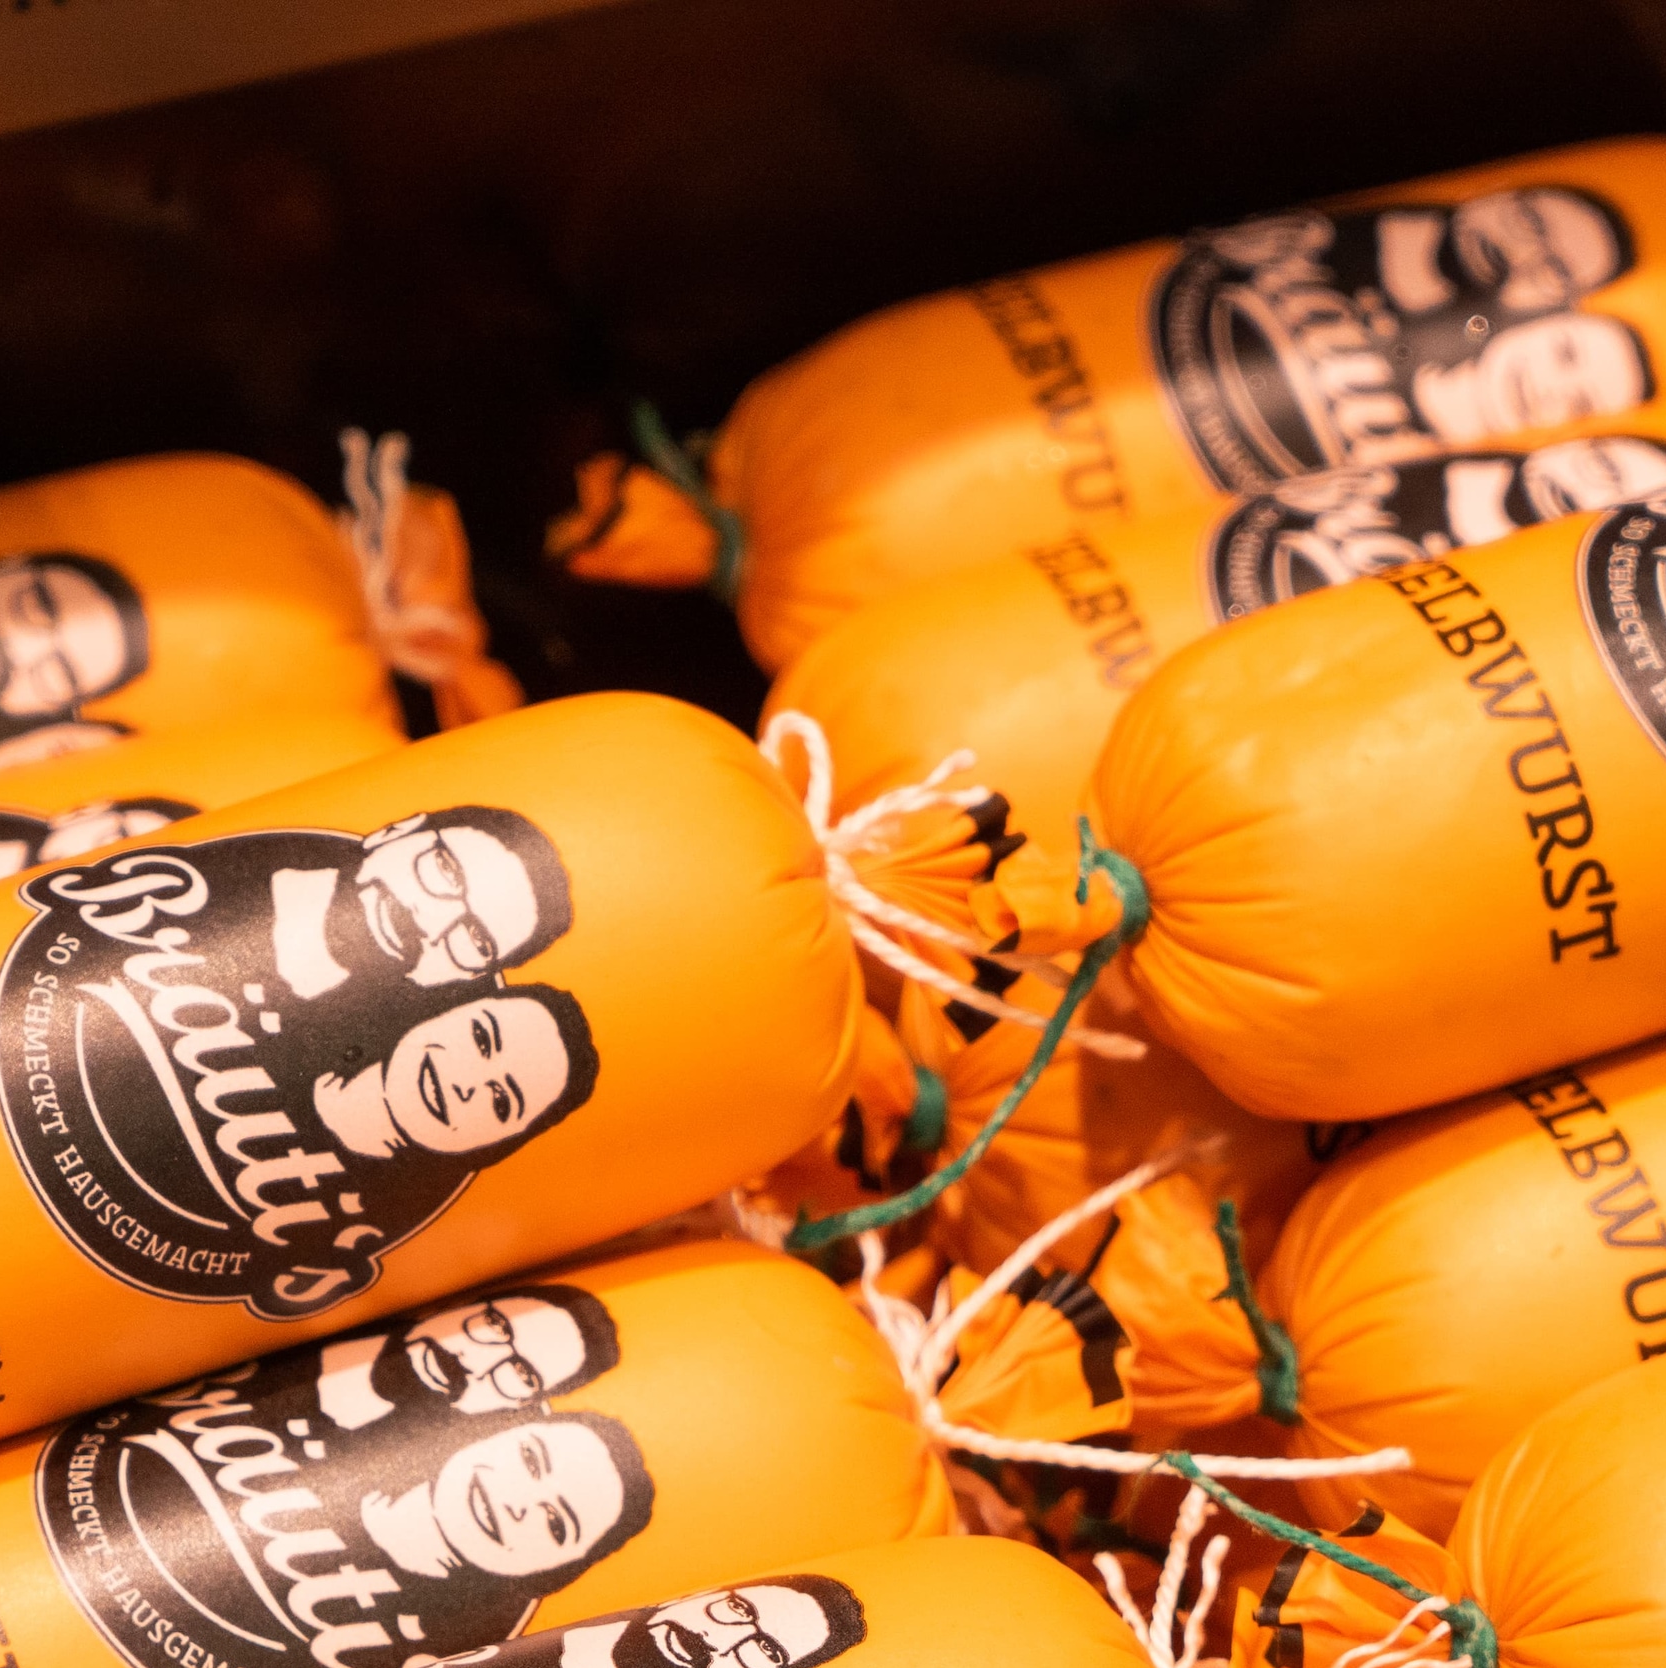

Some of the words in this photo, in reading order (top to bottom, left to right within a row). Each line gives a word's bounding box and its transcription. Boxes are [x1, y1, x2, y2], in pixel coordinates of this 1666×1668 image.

[1608, 541, 1665, 671] SCHMECKT
[46, 932, 81, 965] SO
[24, 971, 70, 1136] SCHMECKT
[49, 854, 385, 1301] Bräuti's
[53, 1144, 251, 1277] HAUSGEMACHT
